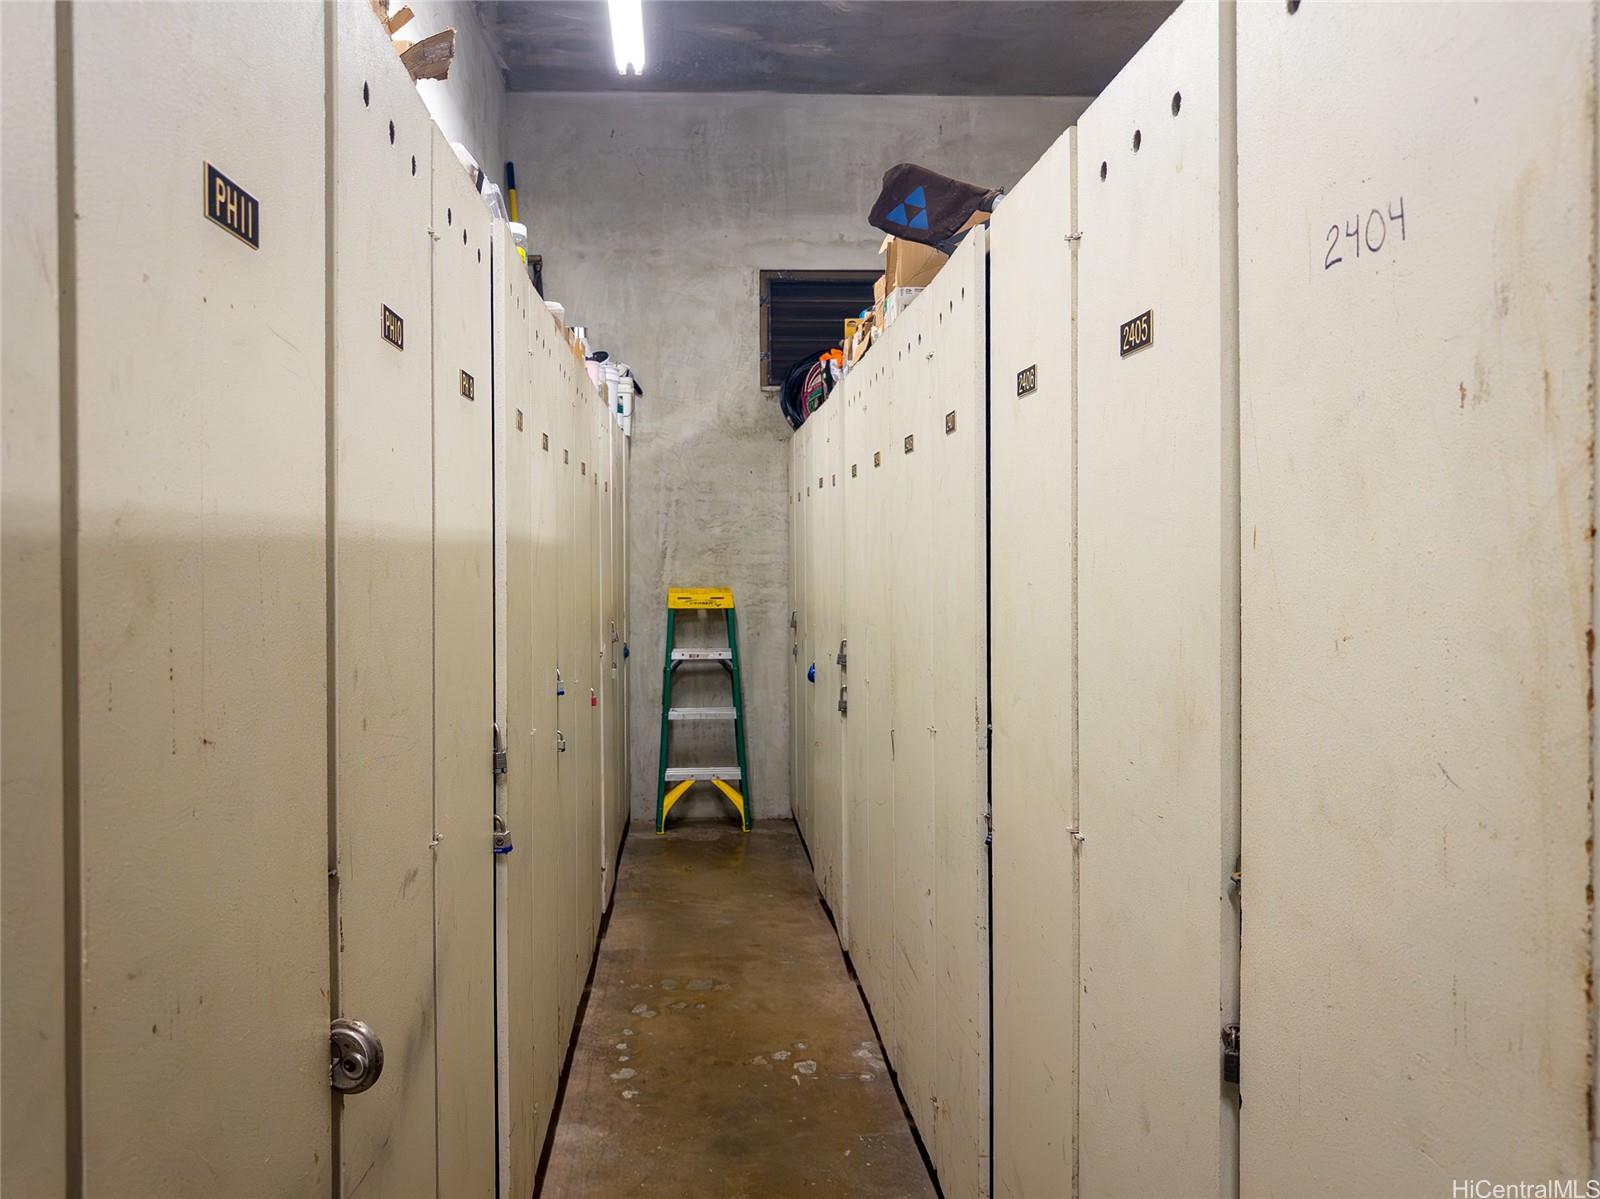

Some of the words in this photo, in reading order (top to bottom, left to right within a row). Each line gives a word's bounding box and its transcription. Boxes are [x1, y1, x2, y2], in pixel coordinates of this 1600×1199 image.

[1325, 196, 1406, 270] 2404
[386, 310, 402, 345] PH10
[1123, 316, 1148, 350] 2405
[1018, 368, 1034, 393] 2406
